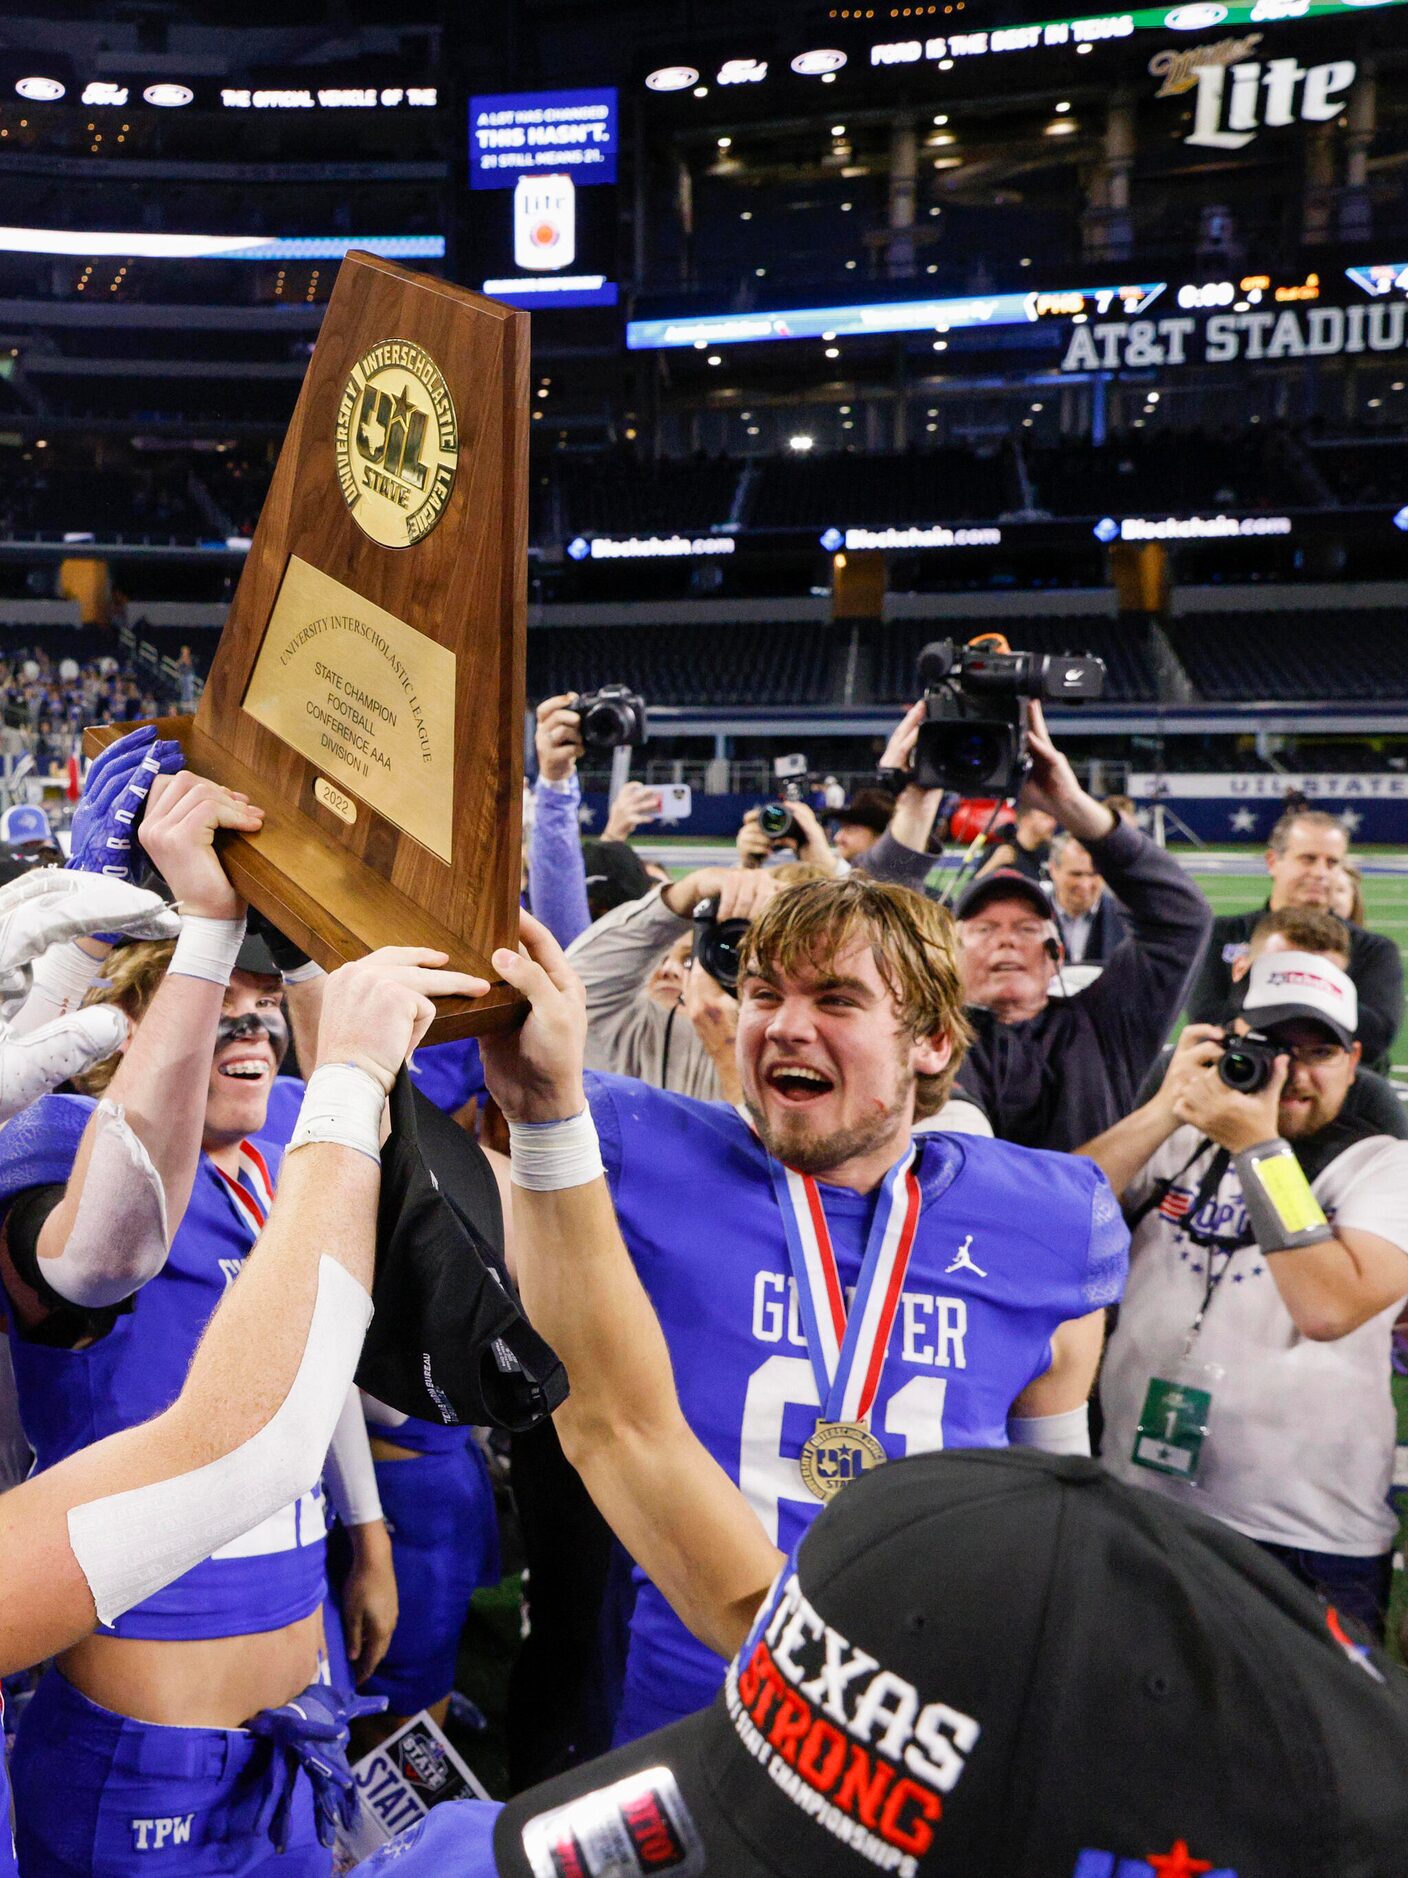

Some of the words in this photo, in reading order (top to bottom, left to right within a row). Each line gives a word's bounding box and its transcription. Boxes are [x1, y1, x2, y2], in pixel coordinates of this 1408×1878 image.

[1184, 57, 1357, 150] Lite
[1061, 317, 1193, 371] AT&T
[1205, 301, 1408, 362] STADIU
[362, 344, 456, 450] INTERSCHOLASTIC
[335, 382, 360, 504] UNIVERSITY
[362, 464, 413, 510] STATE
[591, 536, 735, 558] Blockchain.com
[845, 525, 1001, 550] Blockchain.com
[1121, 514, 1292, 540] Blockchain.com
[279, 617, 329, 667] UNIVERSITY
[330, 615, 414, 695] INTERSCHOLASTIC
[408, 696, 433, 765] LEAGUE
[314, 661, 344, 691] STATE
[343, 681, 398, 727] CHAMPION
[327, 693, 377, 737] FOOTBALL
[305, 701, 369, 755] CONFERENCE
[370, 748, 393, 772] AAA
[320, 732, 362, 776] DIVISION
[102, 756, 162, 880] ORDAN
[322, 785, 350, 815] 2022
[766, 1573, 982, 1794] TEXAS
[738, 1639, 944, 1858] STRONG
[132, 1813, 195, 1850] TPW
